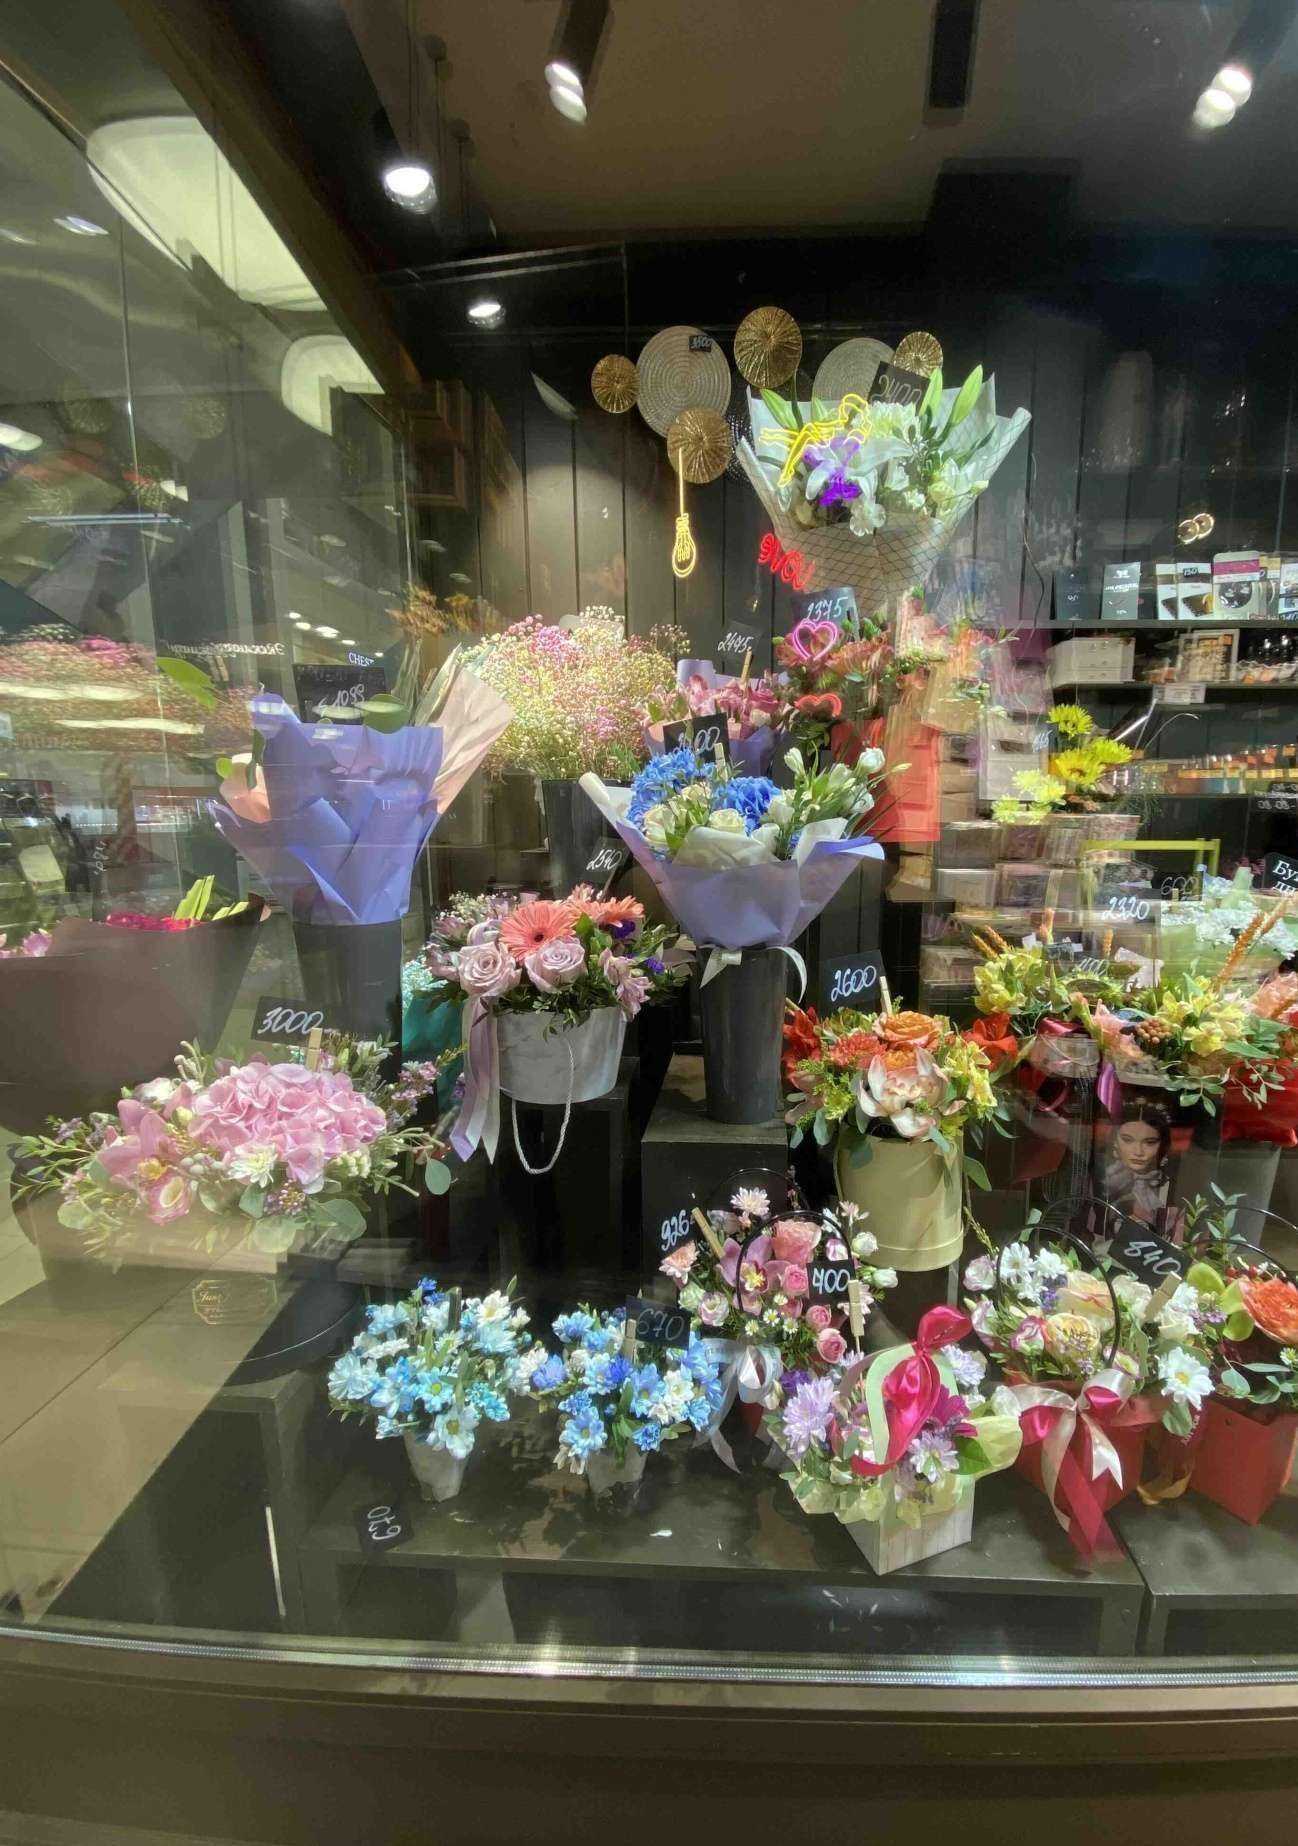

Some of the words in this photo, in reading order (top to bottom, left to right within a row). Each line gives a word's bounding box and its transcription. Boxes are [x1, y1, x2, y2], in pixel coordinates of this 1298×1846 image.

[831, 965, 877, 1002] 2600
[257, 1006, 324, 1035] 3000
[812, 1267, 851, 1295] 400
[637, 1308, 685, 1341] 670
